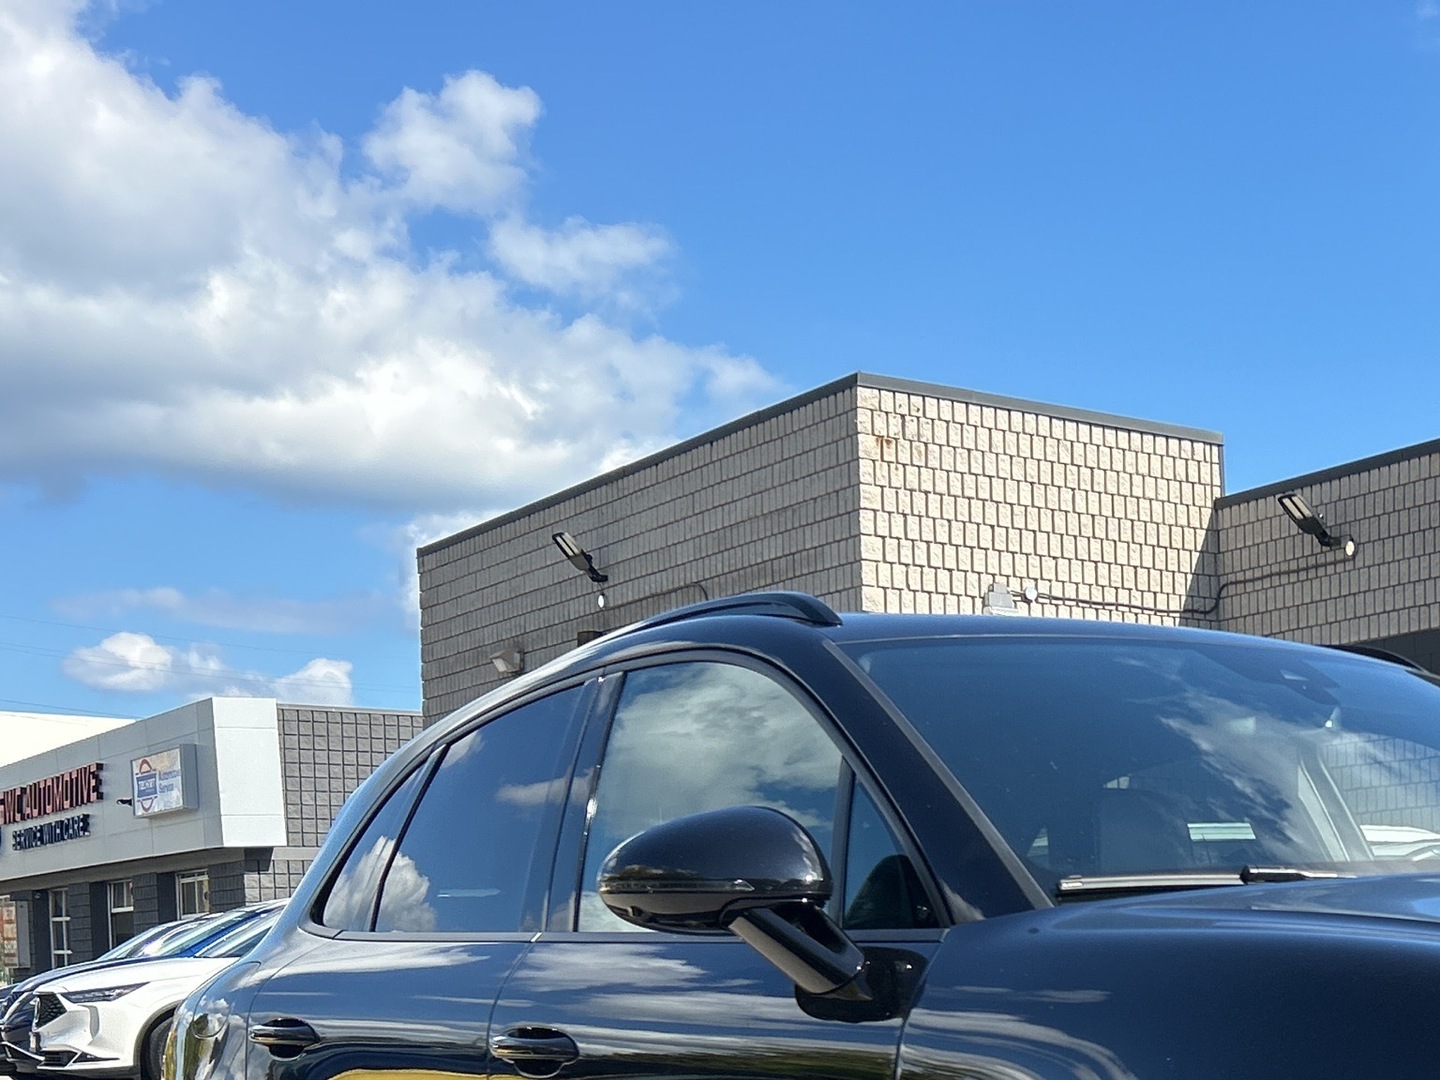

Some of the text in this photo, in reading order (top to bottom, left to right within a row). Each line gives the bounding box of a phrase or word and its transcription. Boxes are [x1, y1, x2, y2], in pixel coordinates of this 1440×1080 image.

[24, 762, 103, 819] AUTOMOTIVE
[13, 826, 42, 850] SERVICE
[42, 820, 62, 845] WITH
